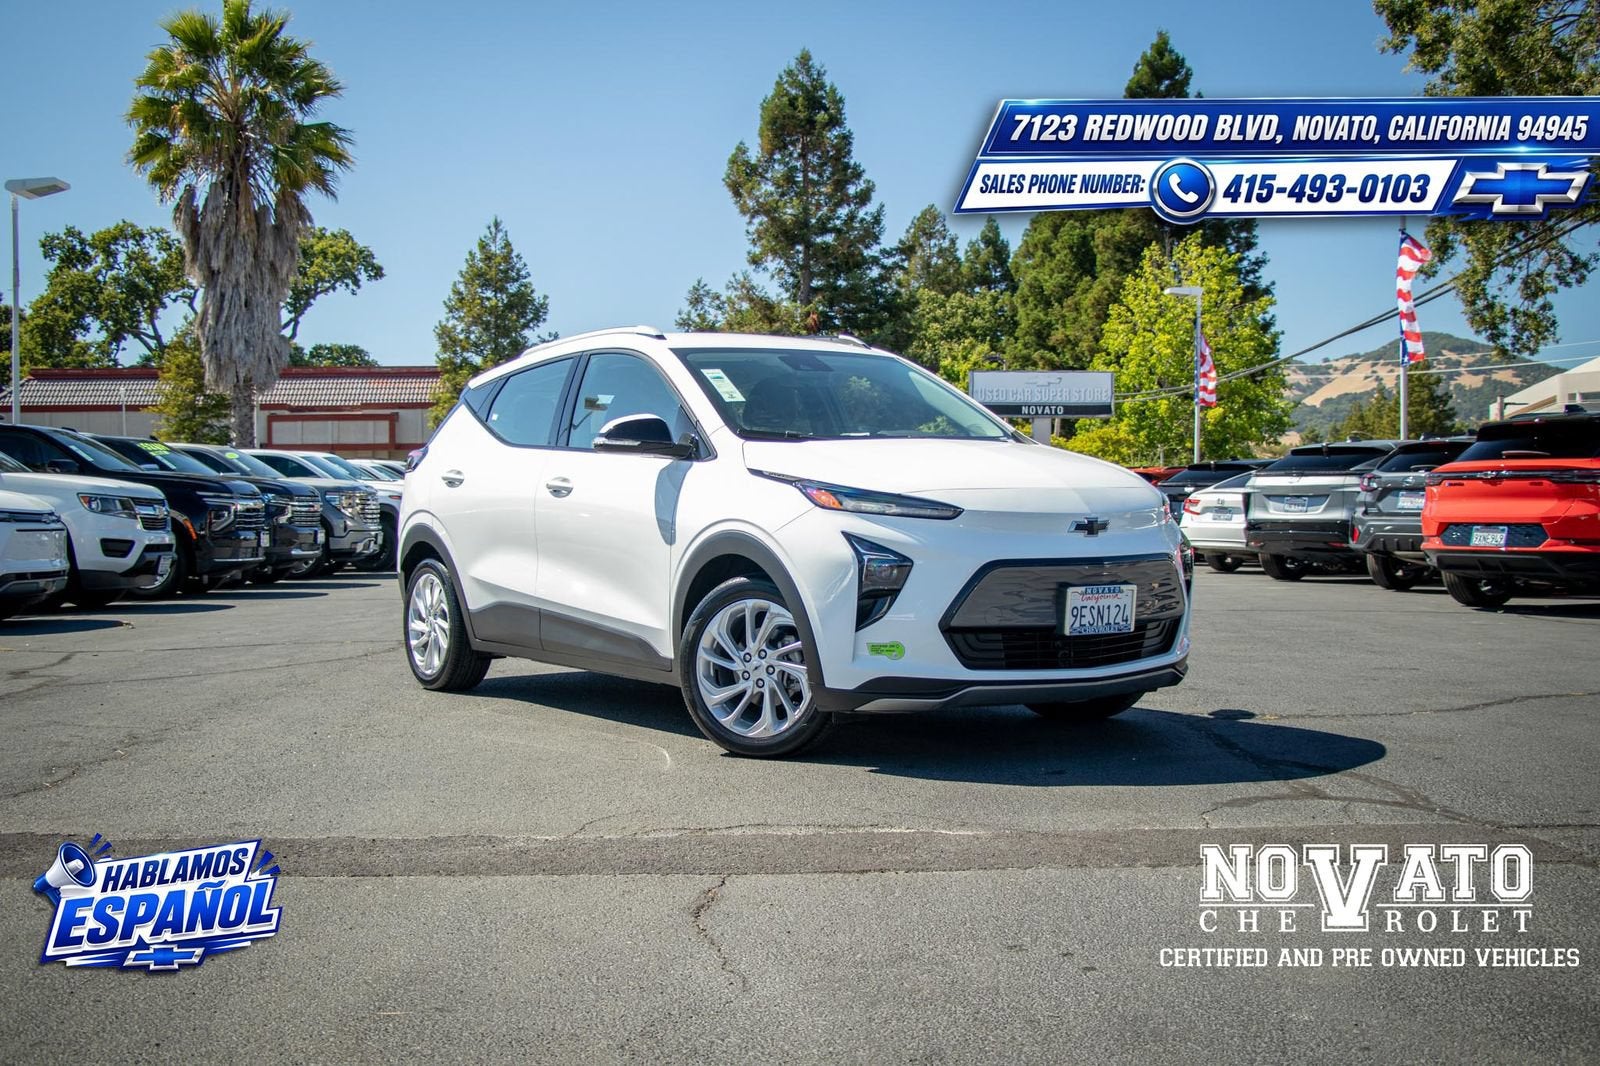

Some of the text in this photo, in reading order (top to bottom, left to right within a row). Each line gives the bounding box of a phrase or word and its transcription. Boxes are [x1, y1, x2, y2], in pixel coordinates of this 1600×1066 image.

[978, 387, 1109, 401] USED CAR SUPER STORE
[1021, 405, 1064, 415] NOVATO
[1085, 586, 1120, 594] NOVATO
[1070, 604, 1129, 627] 9ESN124
[1081, 626, 1120, 634] CHEVROLET
